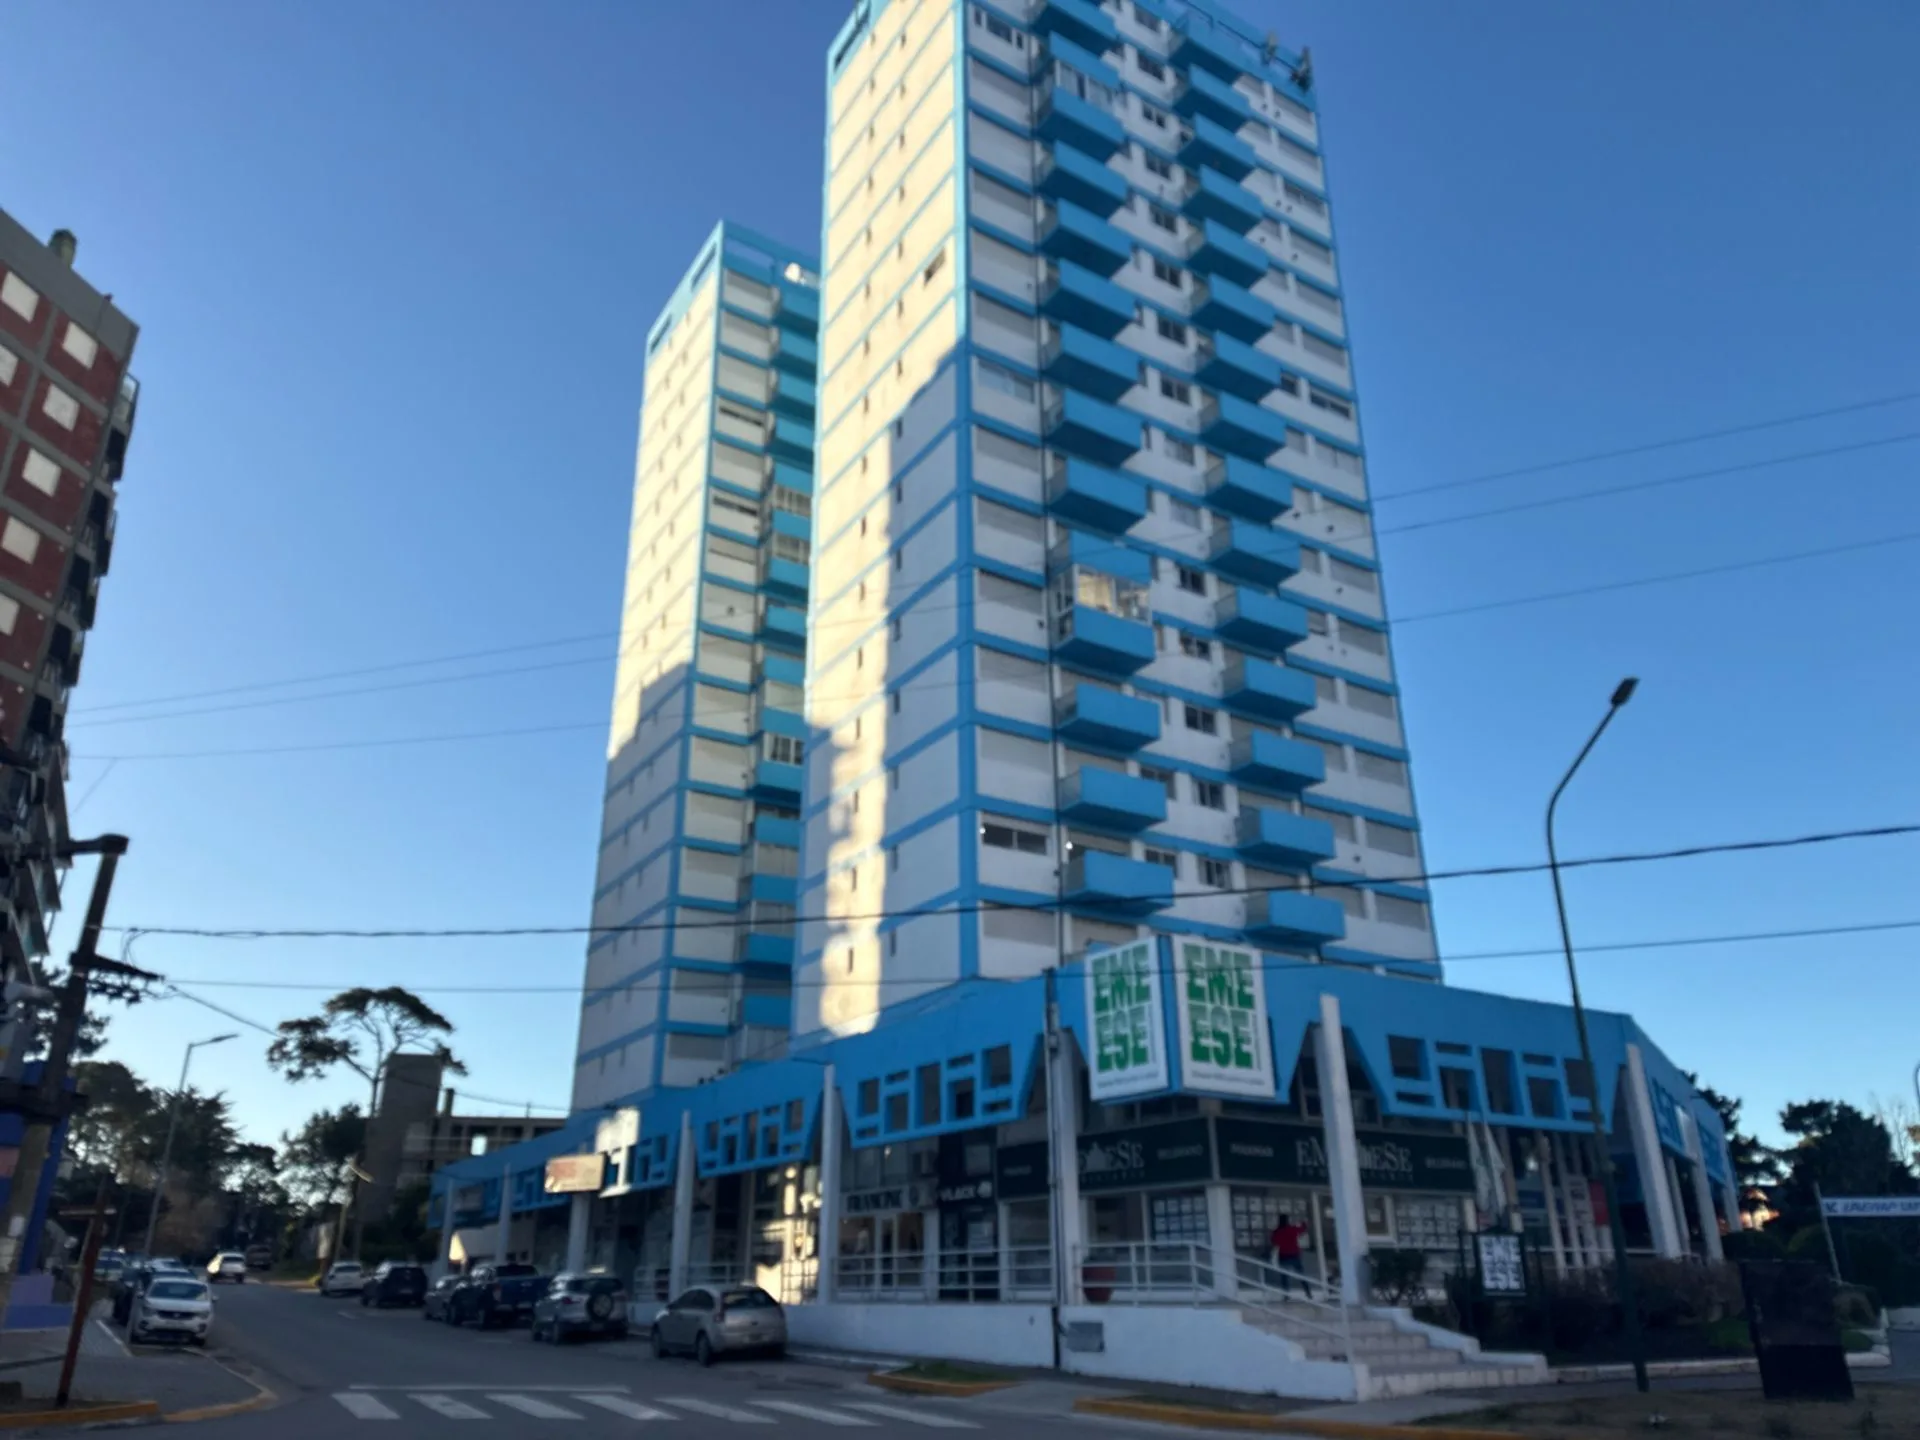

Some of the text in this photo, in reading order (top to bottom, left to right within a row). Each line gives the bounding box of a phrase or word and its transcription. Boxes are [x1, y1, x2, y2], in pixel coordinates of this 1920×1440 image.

[1091, 943, 1150, 1013] EME
[1182, 943, 1255, 1010] EME
[1096, 1005, 1150, 1073] ESE
[1187, 1002, 1254, 1069] ESE
